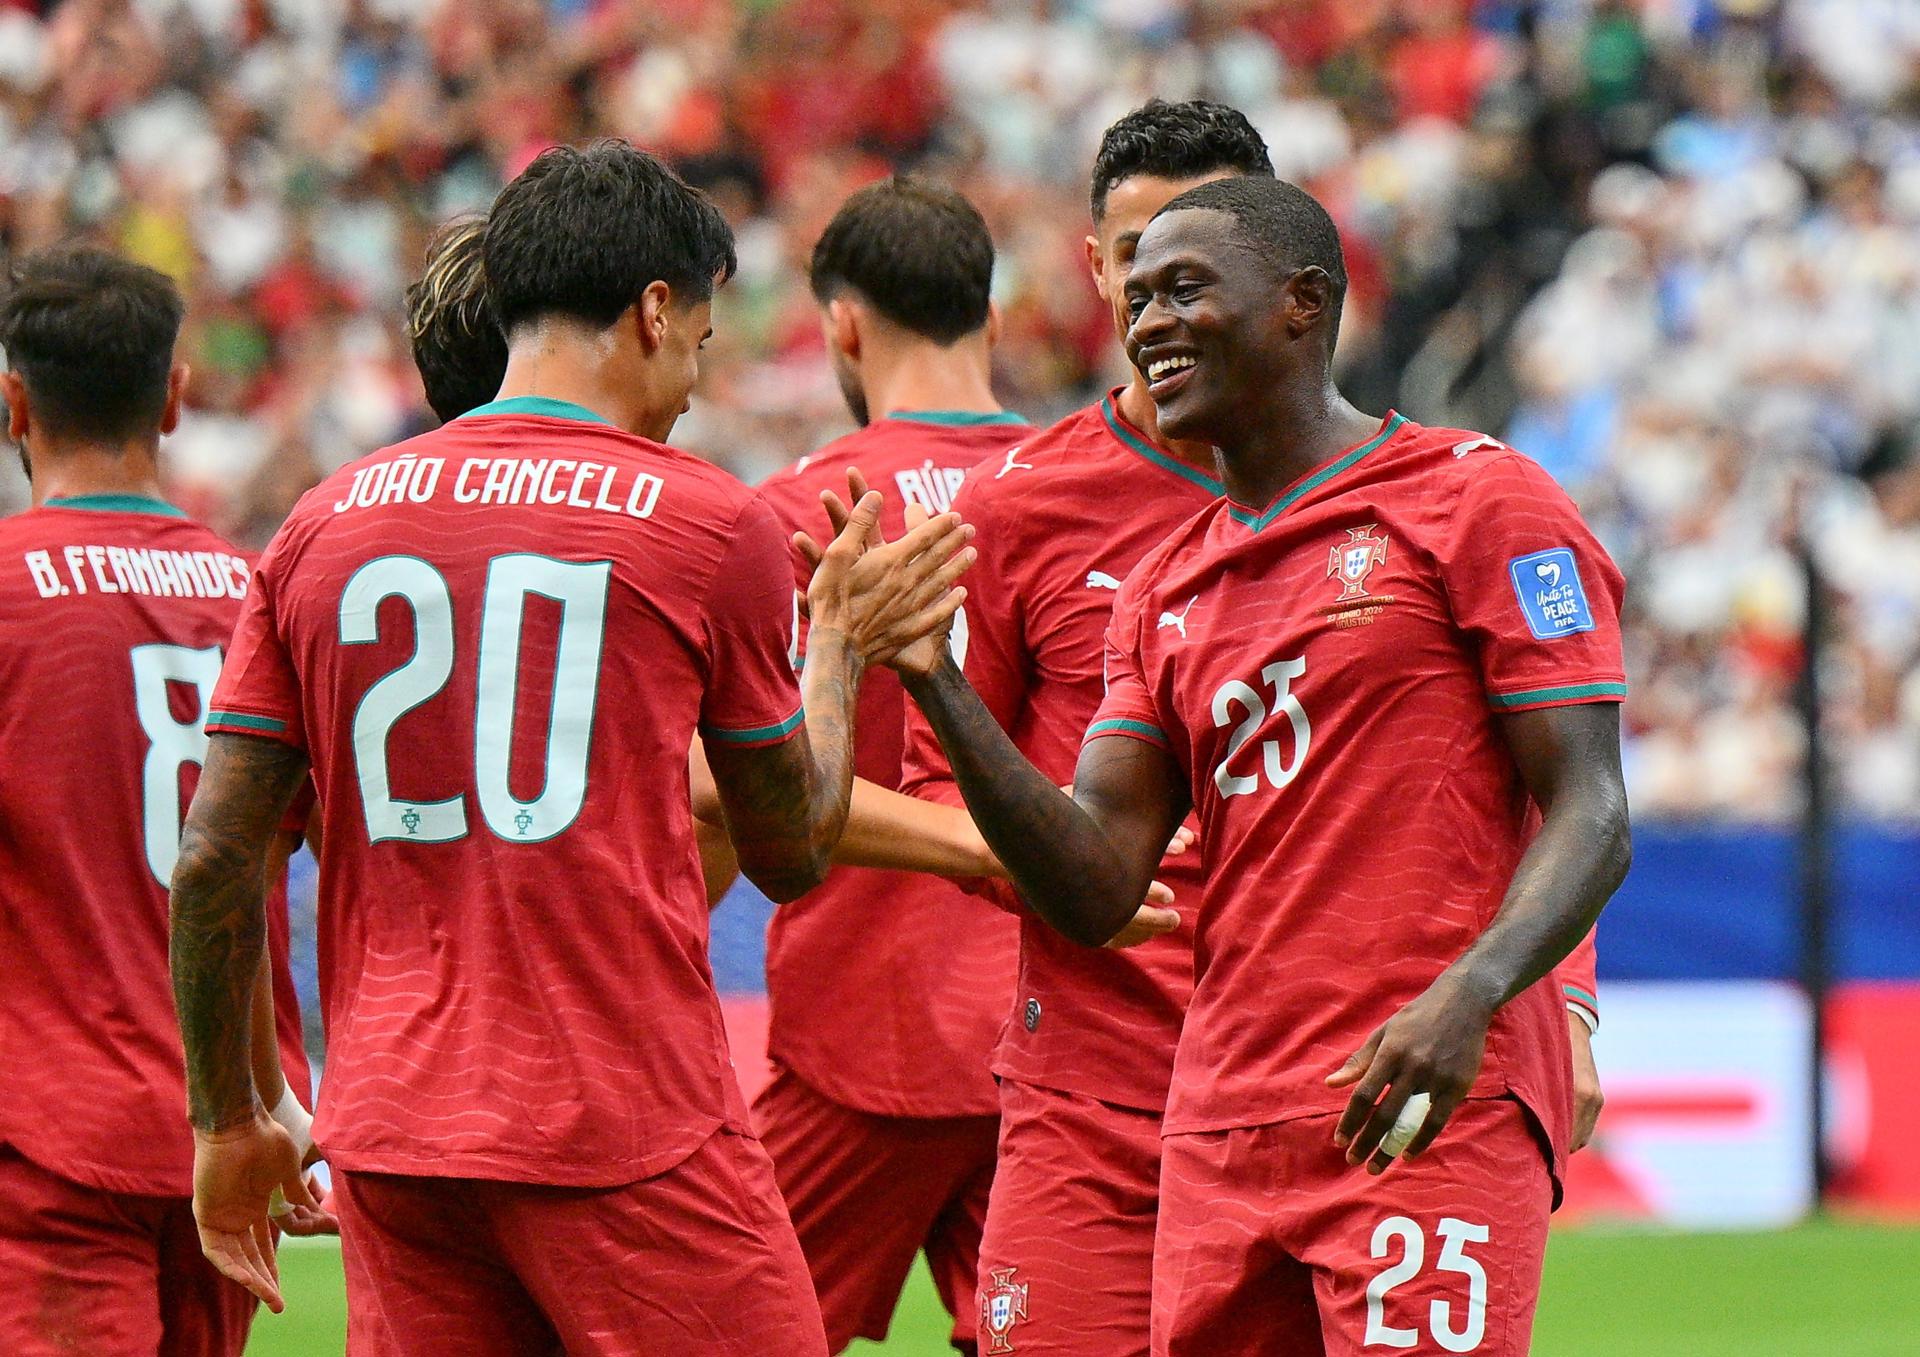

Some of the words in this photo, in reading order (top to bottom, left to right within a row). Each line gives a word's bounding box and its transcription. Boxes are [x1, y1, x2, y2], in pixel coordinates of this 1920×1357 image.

[334, 453, 442, 514] JOÃO
[453, 457, 664, 519] CANCELO
[1336, 615, 1374, 629] HOUSTON
[1364, 606, 1384, 616] 2026
[1542, 599, 1578, 620] PEACE
[1554, 616, 1576, 628] FIFA
[339, 552, 612, 846] 20
[1212, 654, 1311, 800] 25
[130, 642, 224, 891] 8
[1364, 1216, 1489, 1353] 25
